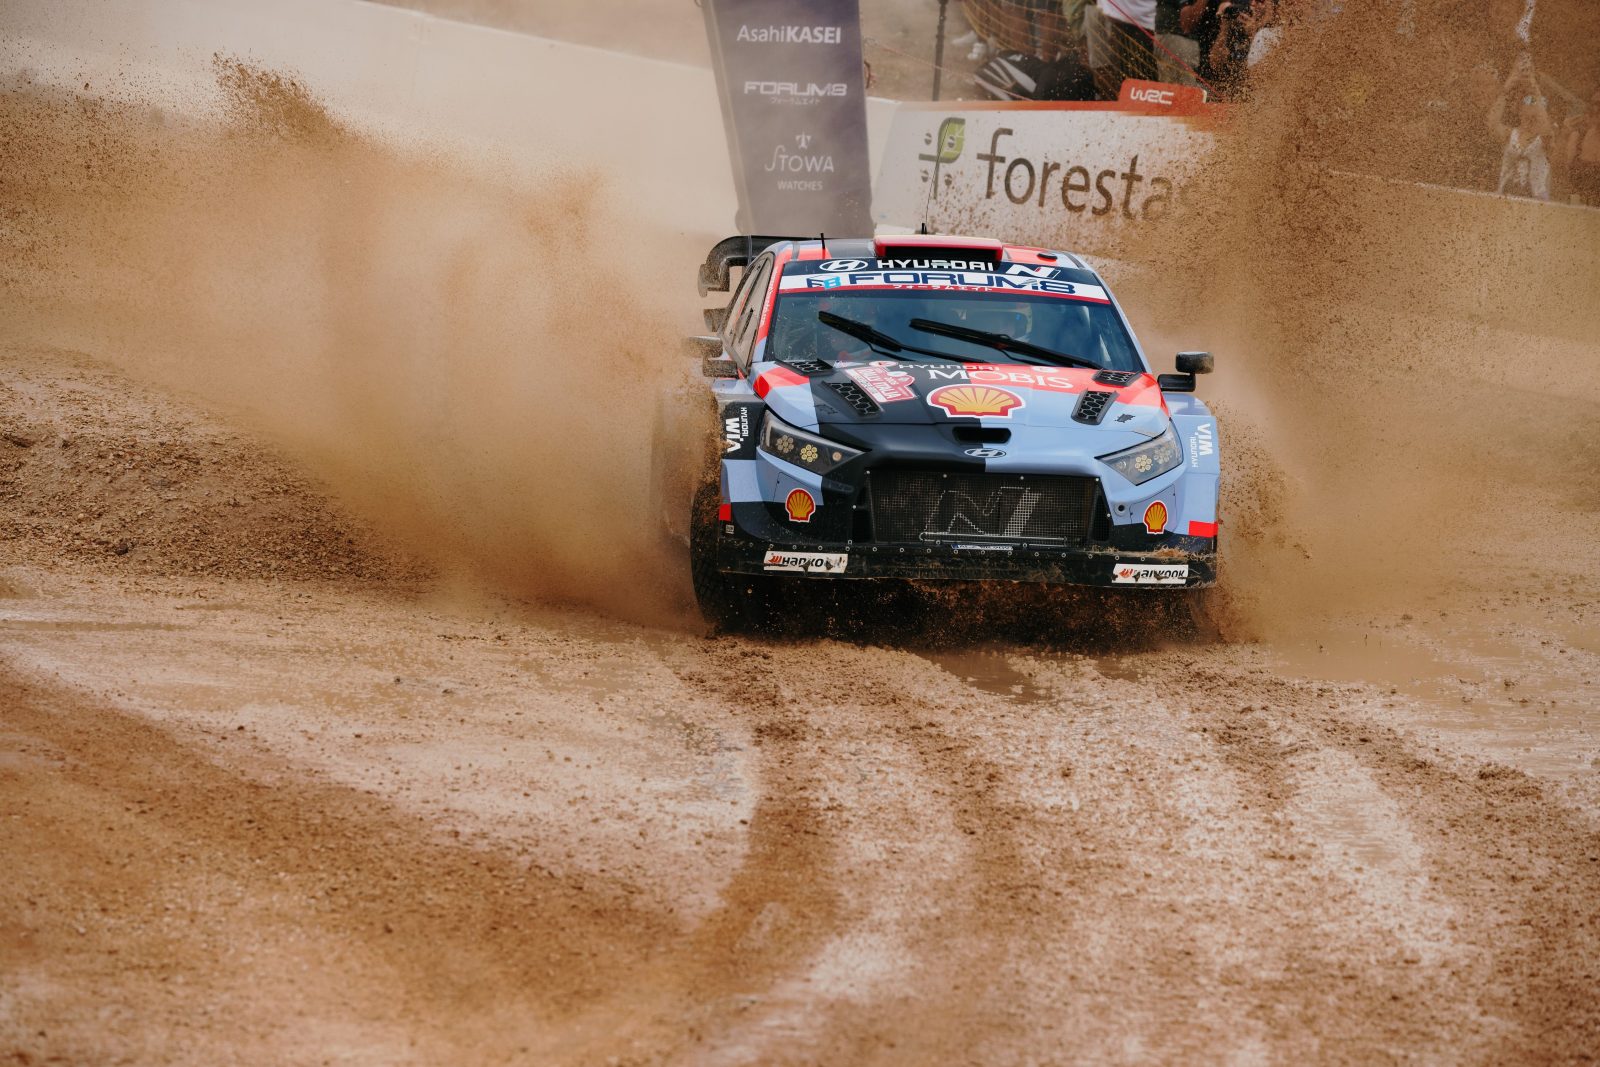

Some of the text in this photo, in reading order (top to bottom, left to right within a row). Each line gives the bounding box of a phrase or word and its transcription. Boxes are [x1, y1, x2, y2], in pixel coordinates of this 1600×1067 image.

[736, 25, 841, 43] AsahiKASEI
[743, 81, 847, 96] FORUM8
[1130, 87, 1174, 105] WRC
[976, 128, 1198, 220] foresta
[777, 181, 823, 191] WATCHES
[877, 259, 994, 272] HYUNDAI
[848, 272, 1076, 294] FORUM8
[928, 369, 1074, 389] MOBIS
[740, 407, 749, 437] HYUNDAI
[1188, 436, 1199, 468] HYUNDAI
